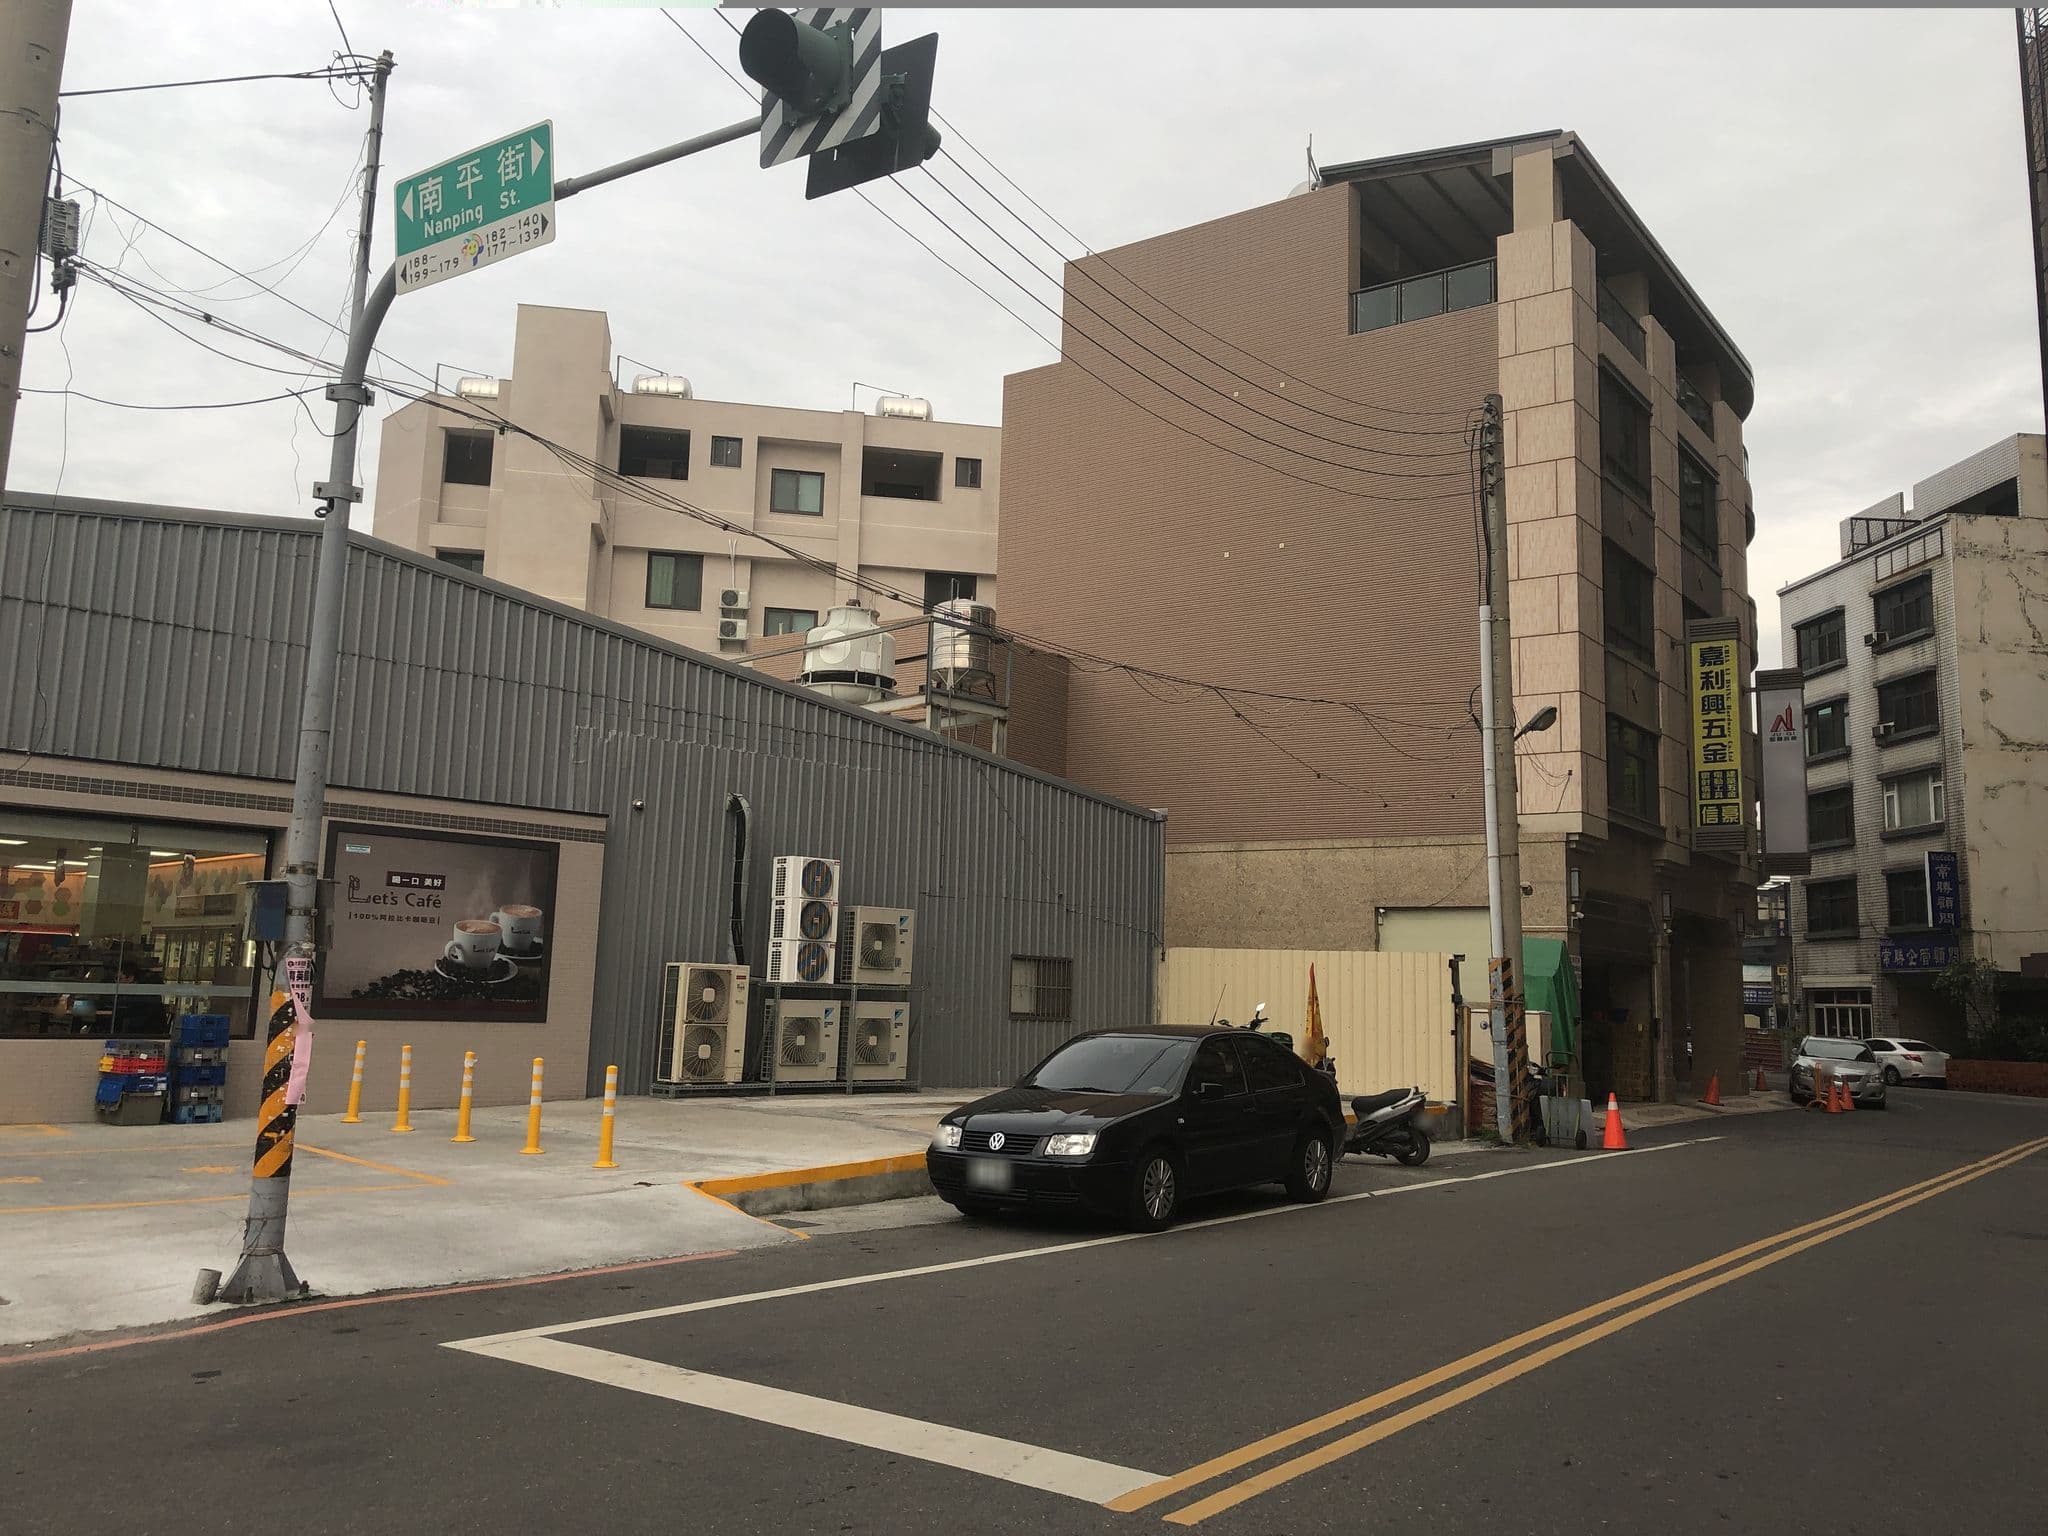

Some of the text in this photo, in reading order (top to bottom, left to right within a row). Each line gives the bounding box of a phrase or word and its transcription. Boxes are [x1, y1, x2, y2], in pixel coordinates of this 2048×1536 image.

[418, 143, 525, 219] 南平街
[424, 189, 520, 238] Nanping St.
[1699, 646, 1728, 763] 嘉利興五金
[348, 874, 442, 908] Let's Café
